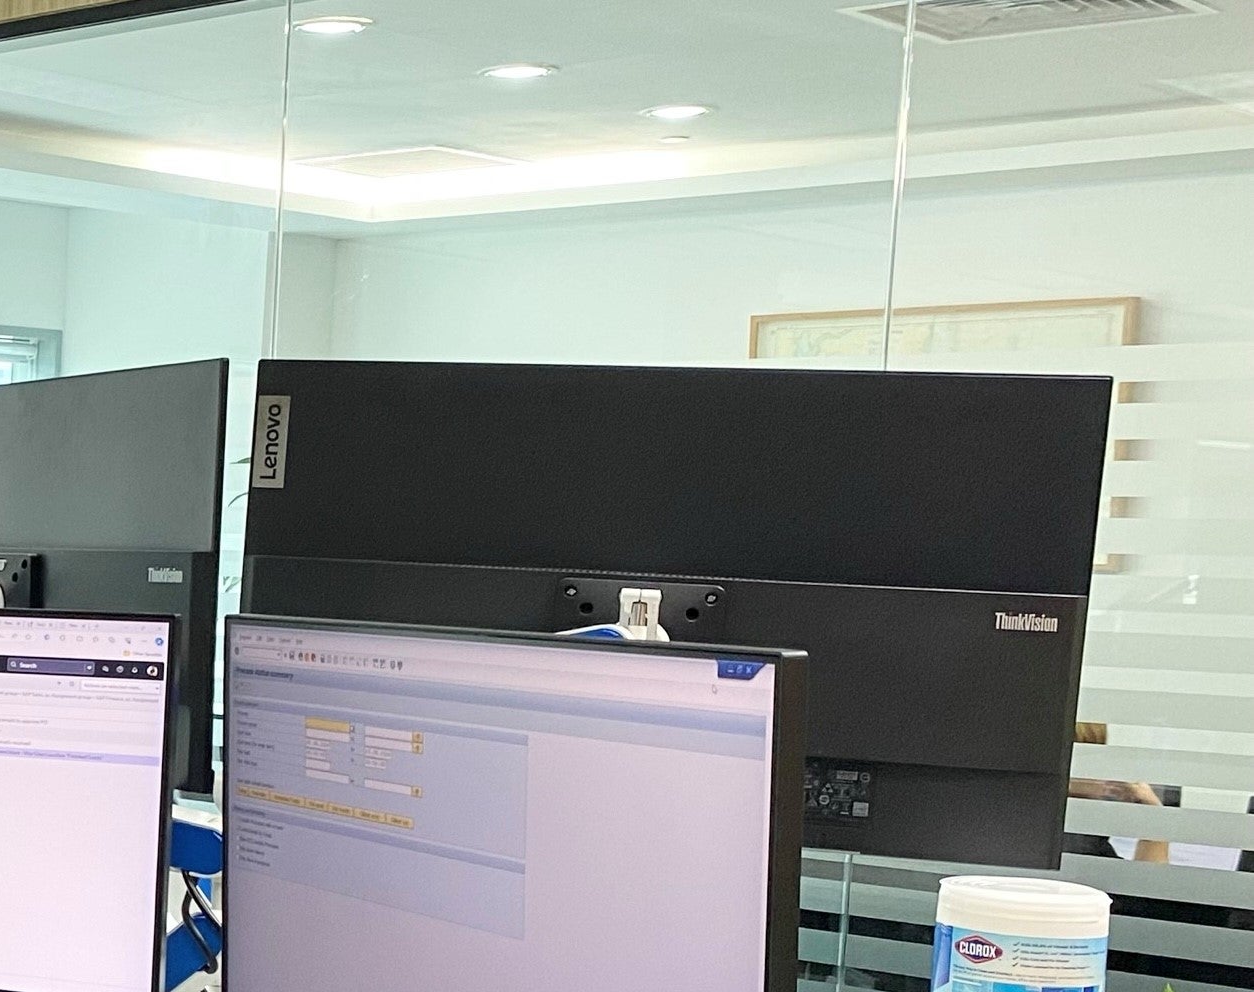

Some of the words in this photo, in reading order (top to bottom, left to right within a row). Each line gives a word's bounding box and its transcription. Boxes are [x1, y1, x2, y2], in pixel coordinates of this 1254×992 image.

[260, 404, 282, 480] Lenovo
[994, 612, 1058, 632] ThinkVision
[958, 941, 997, 958] CLOROX
